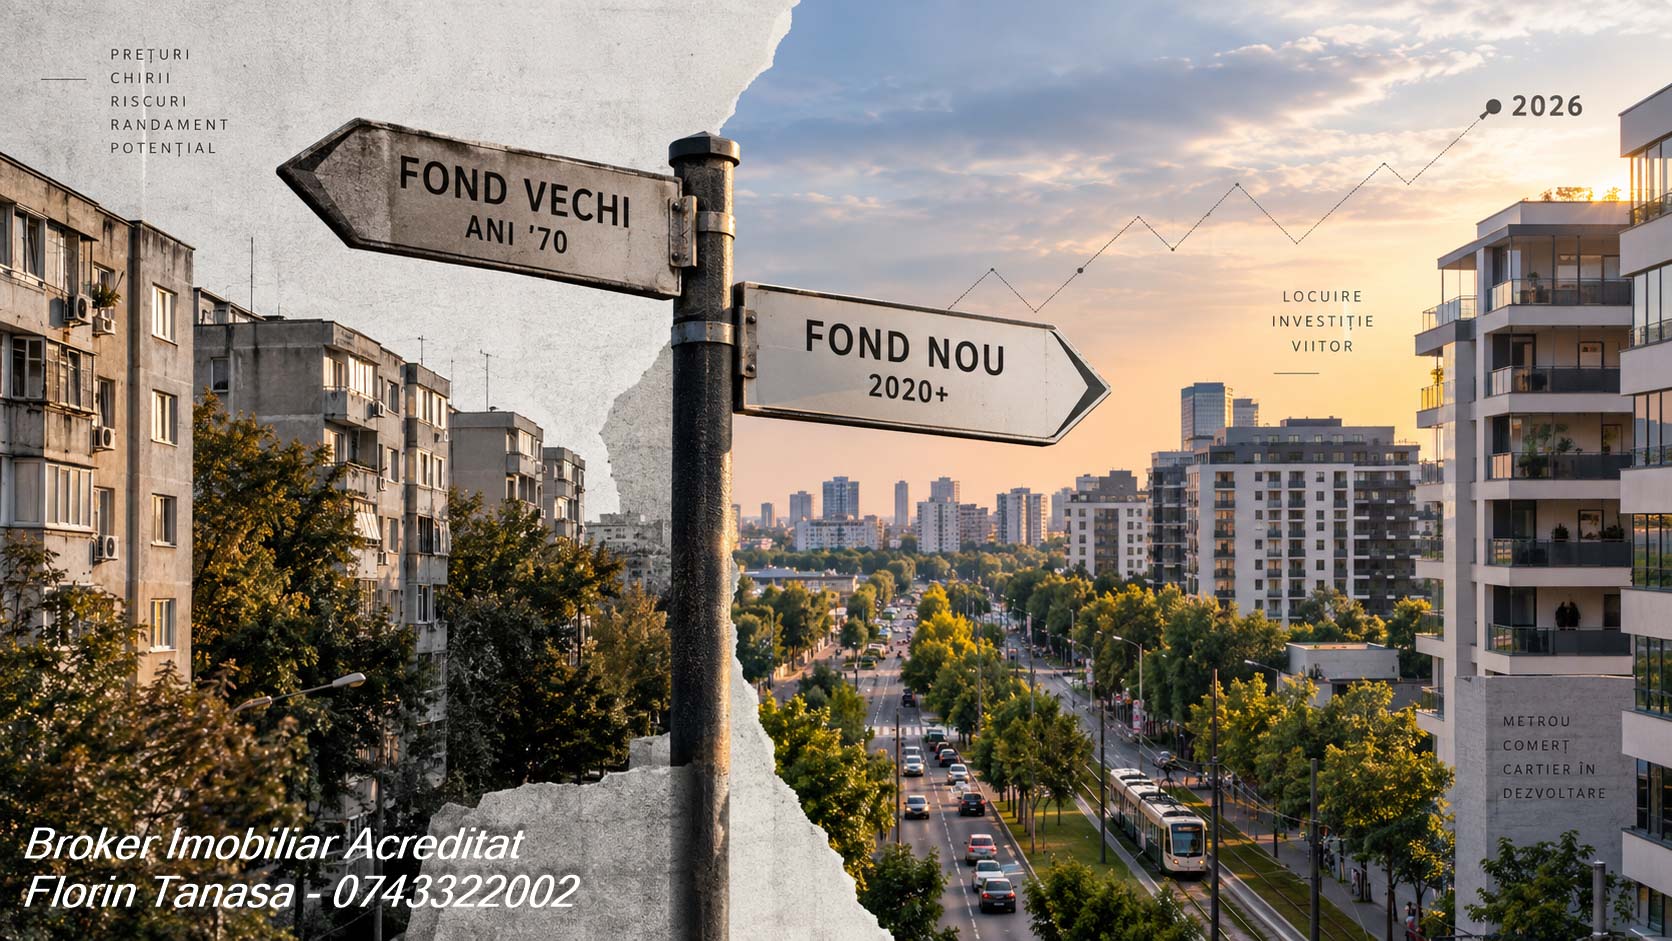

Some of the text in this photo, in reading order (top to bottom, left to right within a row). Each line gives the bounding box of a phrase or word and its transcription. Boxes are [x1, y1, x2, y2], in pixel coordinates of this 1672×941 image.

[400, 155, 630, 228] FOND VECHI
[465, 215, 568, 254] ANI '70
[806, 319, 1004, 376] FOND NOU
[868, 373, 948, 403] 2020+
[1503, 715, 1570, 728] METROU
[1502, 760, 1596, 776] CARTIER ÎN
[1503, 787, 1607, 800] DEZVOLTARE
